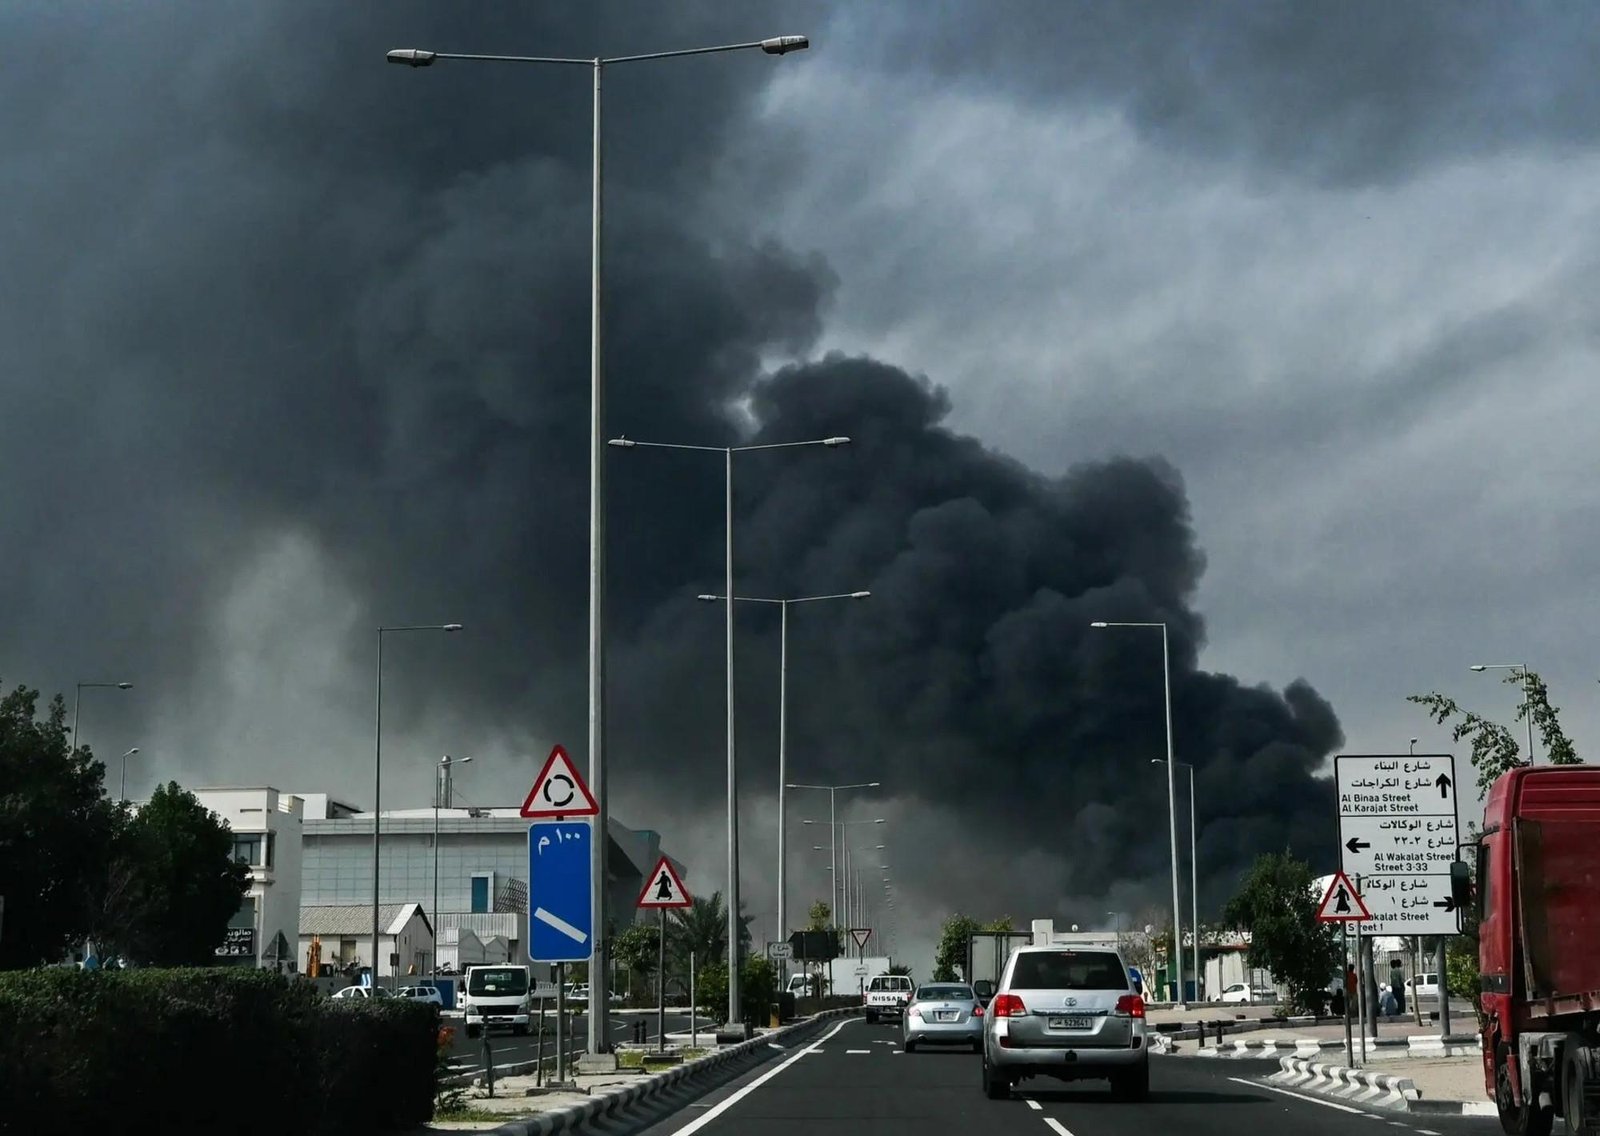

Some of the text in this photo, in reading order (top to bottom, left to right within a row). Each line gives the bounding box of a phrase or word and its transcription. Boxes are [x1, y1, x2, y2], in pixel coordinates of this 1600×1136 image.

[1374, 761, 1431, 773] شارع البناء
[1352, 778, 1432, 790] شارع الكراجات
[1342, 793, 1411, 802] Al Binaa Street
[1342, 803, 1419, 814] Al Karajat Street
[1379, 820, 1454, 832] شارع الوكالات
[538, 827, 581, 856] ١٠٠ م
[1427, 836, 1455, 849] شارع
[1374, 852, 1455, 861] Al Wakalat Street
[1374, 862, 1428, 871] Street 3-33
[1400, 879, 1428, 891] شارع
[1401, 896, 1429, 908] شارع
[1368, 911, 1430, 921] akalat Street
[1348, 923, 1377, 932] Sreet
